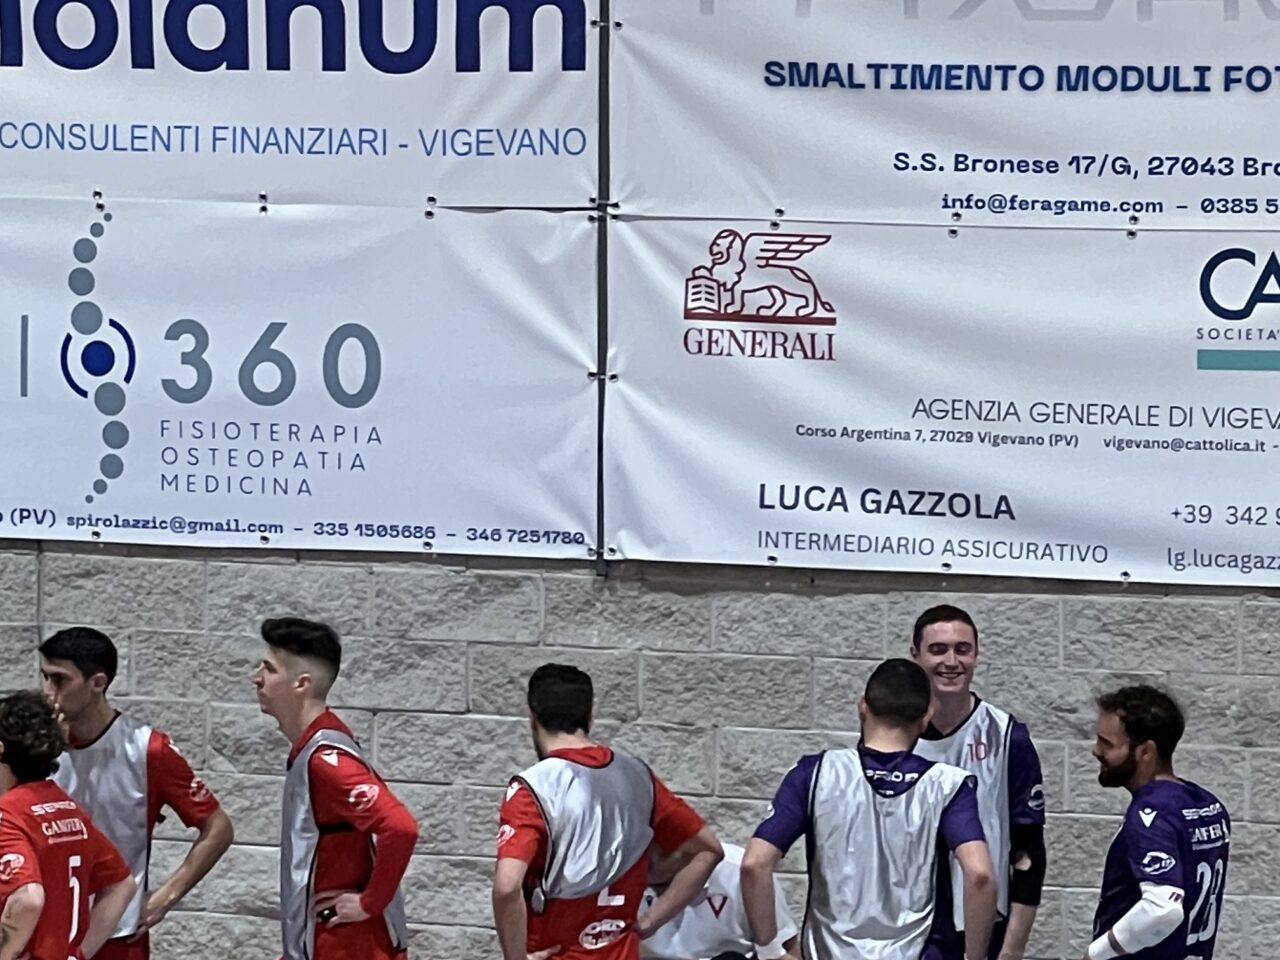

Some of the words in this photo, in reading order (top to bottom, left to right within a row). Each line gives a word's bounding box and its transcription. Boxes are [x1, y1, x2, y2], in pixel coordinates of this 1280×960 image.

[764, 60, 1045, 92] SMALTIMENTO
[1056, 64, 1212, 93] MODULI
[1223, 65, 1280, 93] FO
[211, 125, 388, 156] FINANZIARI
[418, 127, 588, 157] VIGEVANO
[893, 151, 946, 173] S.S.
[953, 153, 1060, 175] Bronese
[1147, 156, 1235, 177] 27043
[941, 193, 1164, 215] info@feragame.com
[1200, 198, 1259, 214] 0385
[683, 327, 836, 361] GENERALI
[160, 318, 383, 409] 360
[911, 398, 1022, 423] AGENZIA
[1028, 402, 1161, 427] GENERALE
[1169, 405, 1194, 428] DI
[1201, 406, 1280, 430] VIGEV
[159, 419, 383, 446] FISIOTERAPIA
[795, 423, 837, 438] Corso
[840, 425, 912, 443] Argentina
[914, 428, 927, 443] 7,
[929, 430, 974, 443] 27029
[977, 431, 1045, 448] Vigevano
[1048, 433, 1080, 449] (PV)
[1103, 435, 1267, 453] vigevano@cattolica.it
[160, 446, 366, 473] OSTEOPATIA
[159, 473, 313, 498] MEDICINA
[758, 483, 850, 514] LUCA
[859, 487, 1017, 521] GAZZOLA
[1170, 504, 1213, 524] +39
[1225, 505, 1269, 526] 342
[10, 505, 57, 528] (PV)
[66, 513, 284, 535] spirolazzic@gmail.com
[313, 521, 349, 537] 335
[354, 522, 437, 540] 1505686
[466, 527, 502, 543] 346
[506, 528, 586, 546] 7251780
[757, 530, 935, 556] INTERMEDIARIO
[941, 538, 1109, 564] ASSICURATIVO
